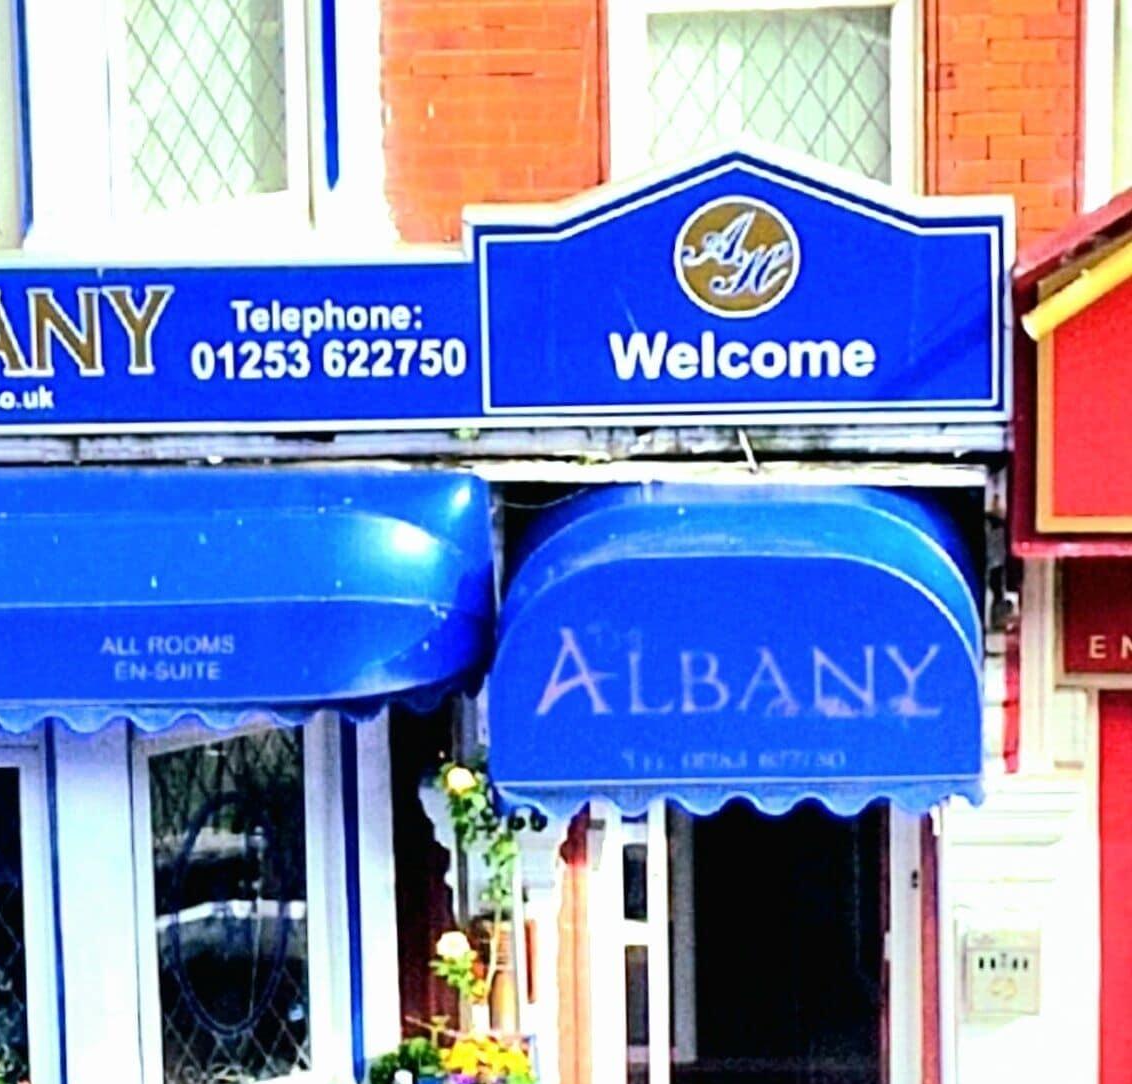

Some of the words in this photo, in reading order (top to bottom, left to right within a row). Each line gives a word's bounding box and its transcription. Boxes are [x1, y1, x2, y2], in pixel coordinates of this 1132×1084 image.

[231, 299, 423, 334] Telephone:
[190, 341, 312, 381] 01253
[322, 338, 468, 379] 622750
[609, 331, 876, 379] Welcome
[100, 635, 141, 656] ALL
[147, 634, 235, 655] ROOMS
[114, 660, 221, 681] EN-SUITE
